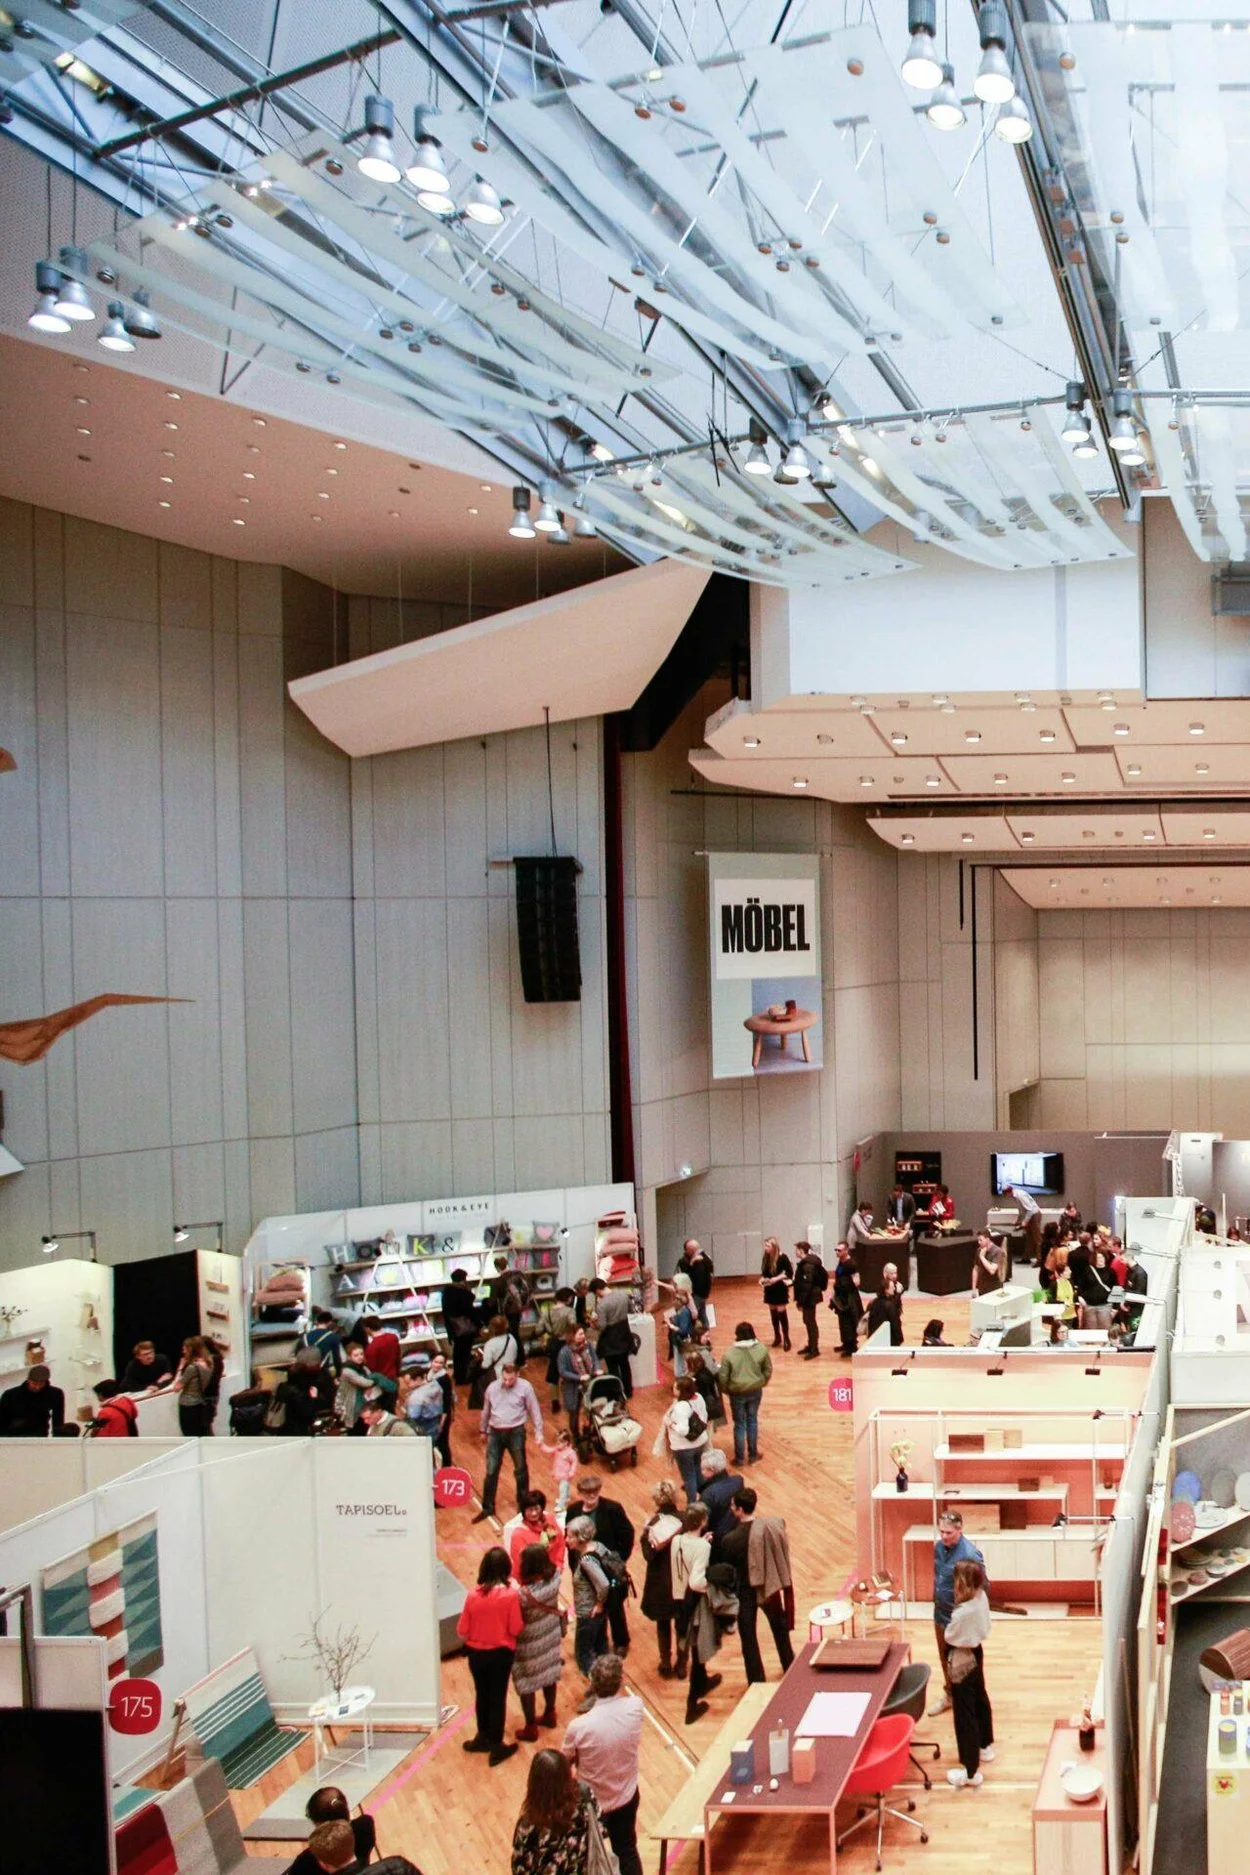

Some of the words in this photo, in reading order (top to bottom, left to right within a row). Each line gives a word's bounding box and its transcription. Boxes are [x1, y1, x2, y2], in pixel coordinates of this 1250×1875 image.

[721, 898, 811, 953] MÖBEL
[833, 1388, 852, 1402] 181
[442, 1479, 465, 1496] 173
[120, 1696, 153, 1718] 175
